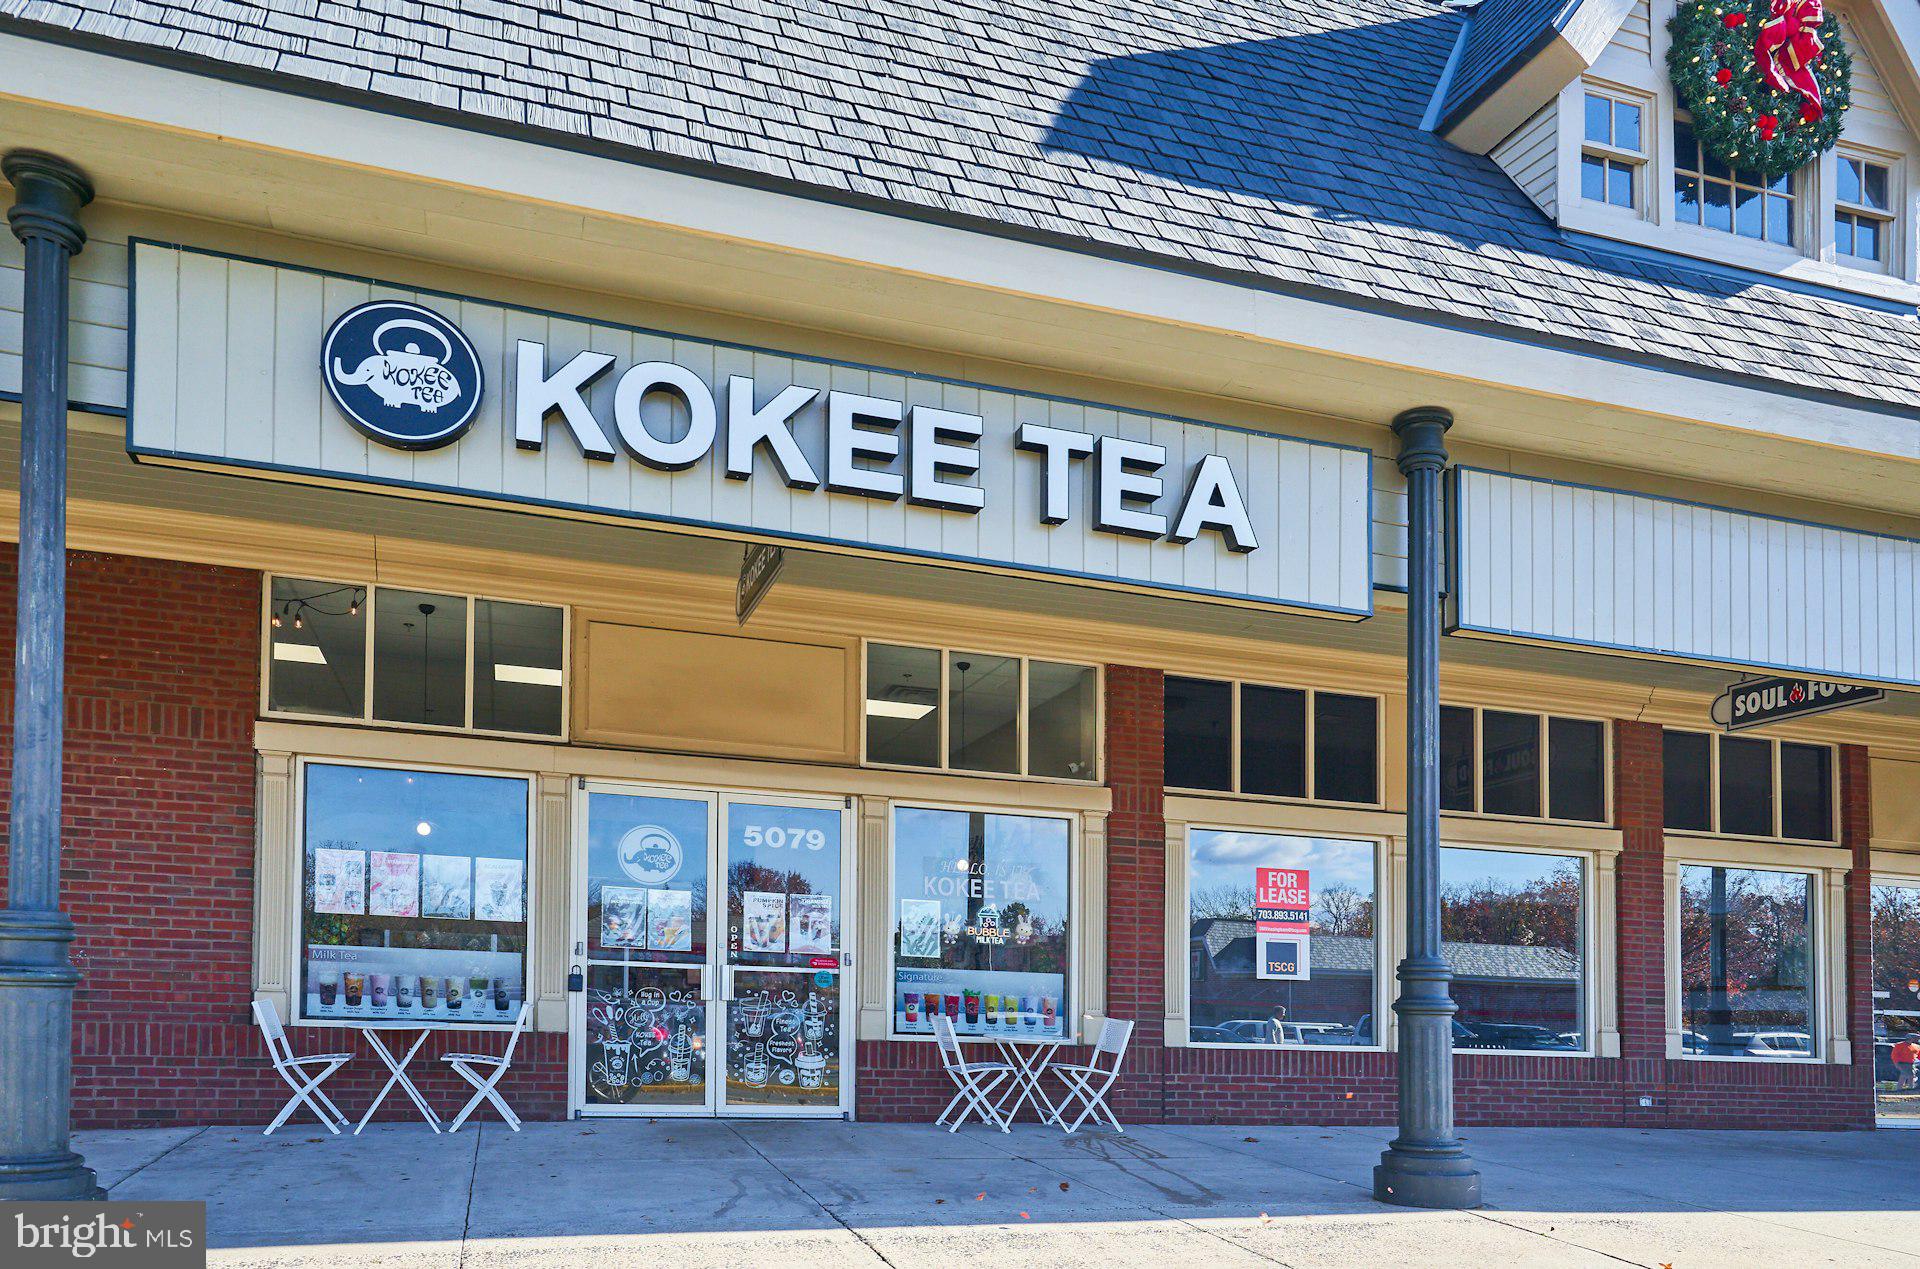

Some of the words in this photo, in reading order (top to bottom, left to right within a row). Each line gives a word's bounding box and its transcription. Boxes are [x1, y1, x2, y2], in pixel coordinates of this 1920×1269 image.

[382, 359, 452, 390] KOKEE
[411, 386, 444, 403] TEA
[515, 338, 985, 514] KOKEE
[1015, 422, 1259, 553] TEA
[1735, 685, 1788, 717] SOUL
[743, 825, 826, 851] 5079
[924, 875, 995, 899] KOKEE
[999, 879, 1041, 901] TEA
[1268, 871, 1298, 888] FOR
[1259, 887, 1307, 905] LEASE
[1257, 910, 1308, 921] 703.893.5141
[967, 926, 1011, 938] BUBBLE
[990, 936, 1005, 945] TEA
[730, 925, 738, 958] OPEN
[312, 949, 337, 960] Milk
[338, 950, 358, 961] Tea
[1268, 961, 1296, 973] TSCG
[898, 971, 944, 983] Signature
[780, 1025, 792, 1033] Tea
